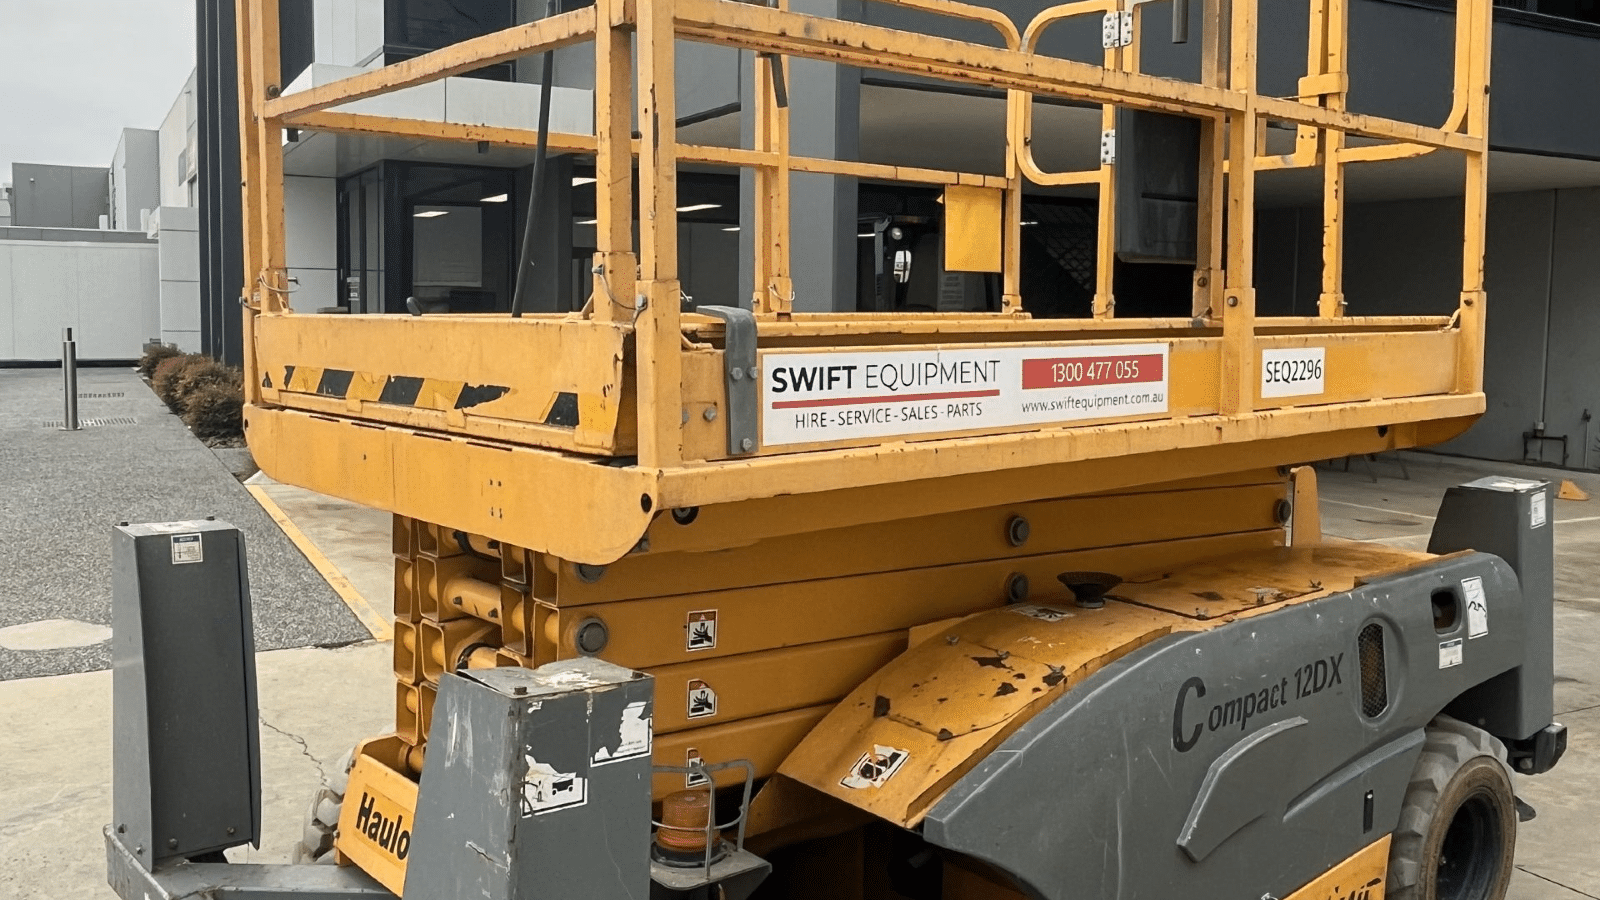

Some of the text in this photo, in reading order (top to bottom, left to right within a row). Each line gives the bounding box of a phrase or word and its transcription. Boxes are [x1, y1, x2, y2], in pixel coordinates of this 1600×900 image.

[771, 360, 1001, 393] SWIFT EQUIPMENT
[1051, 360, 1140, 383] 1300 477 055
[1265, 359, 1322, 384] SEQ2296
[1021, 393, 1164, 413] www.swiftequipment.com.au
[1173, 652, 1344, 753] Compact 12DX
